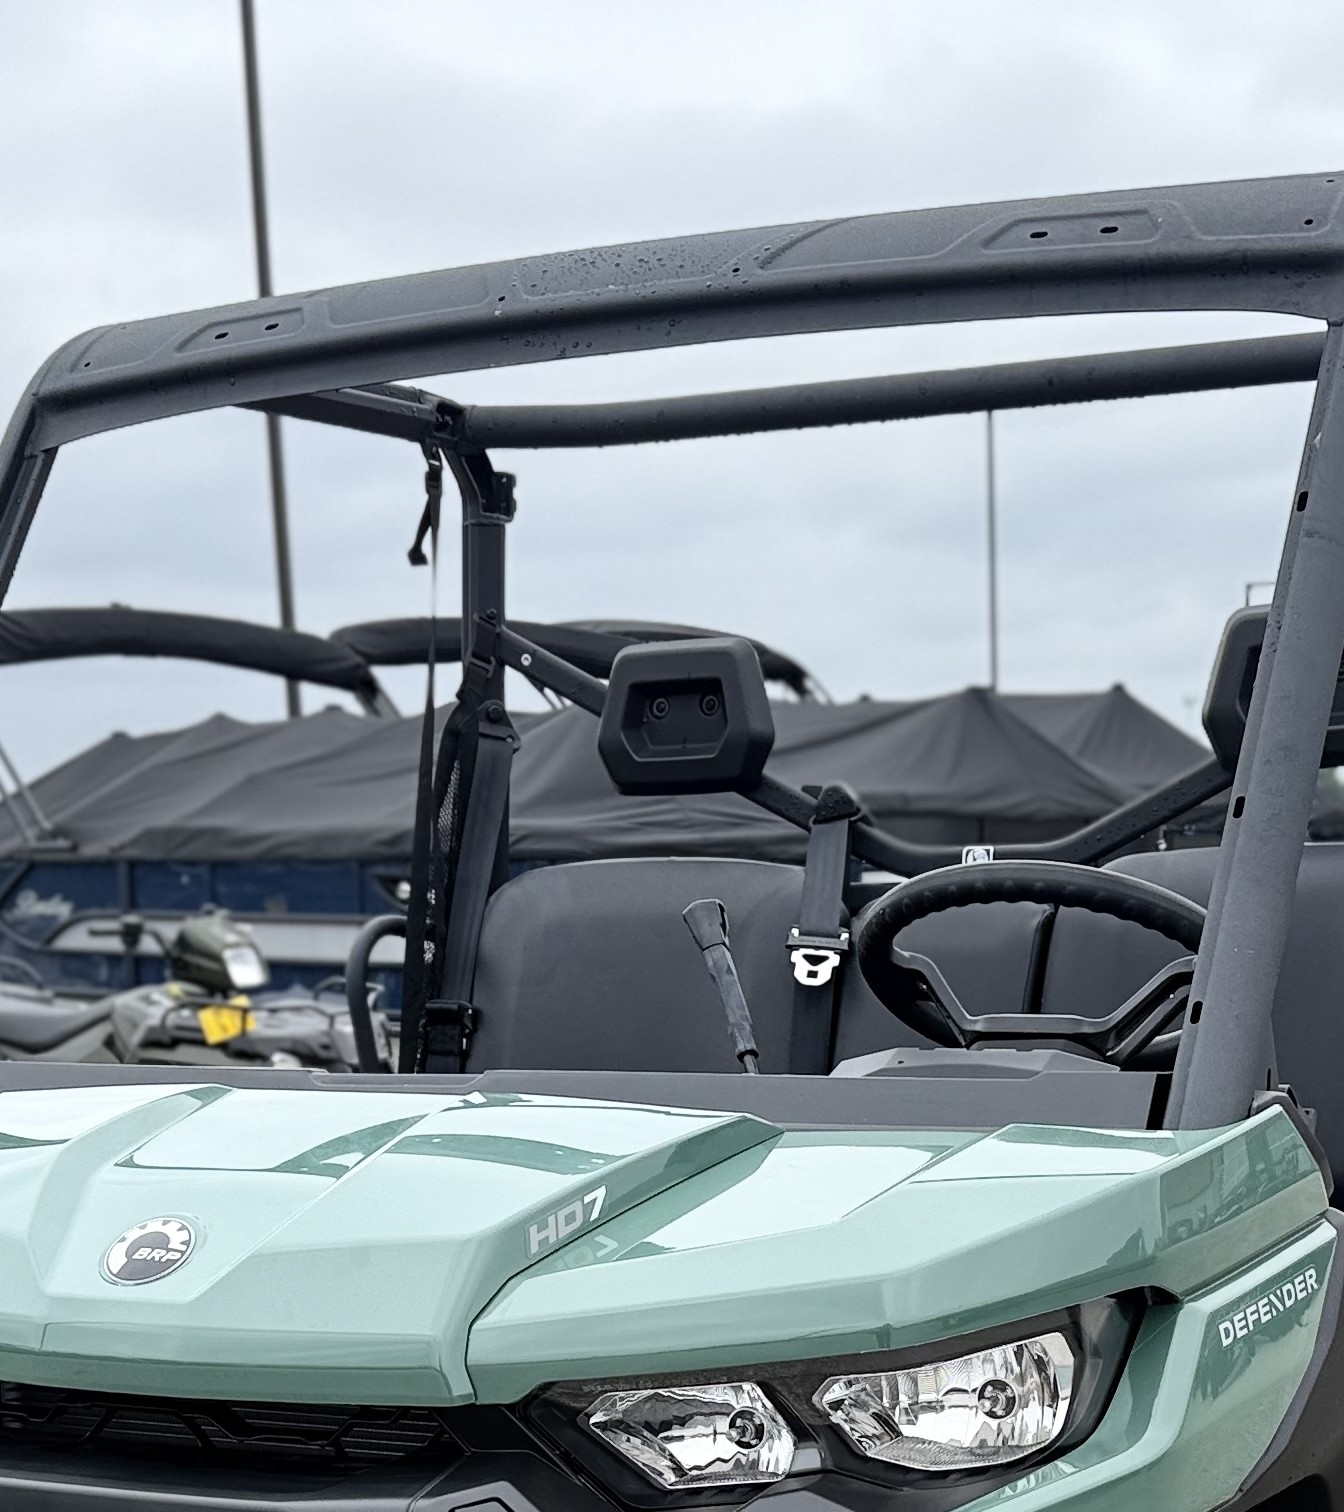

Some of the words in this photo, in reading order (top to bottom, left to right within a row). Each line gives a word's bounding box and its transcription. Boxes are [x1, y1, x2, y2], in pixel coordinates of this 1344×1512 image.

[131, 1247, 182, 1263] BRP
[529, 1184, 607, 1255] HD7
[1218, 1267, 1318, 1348] DEFENDER
